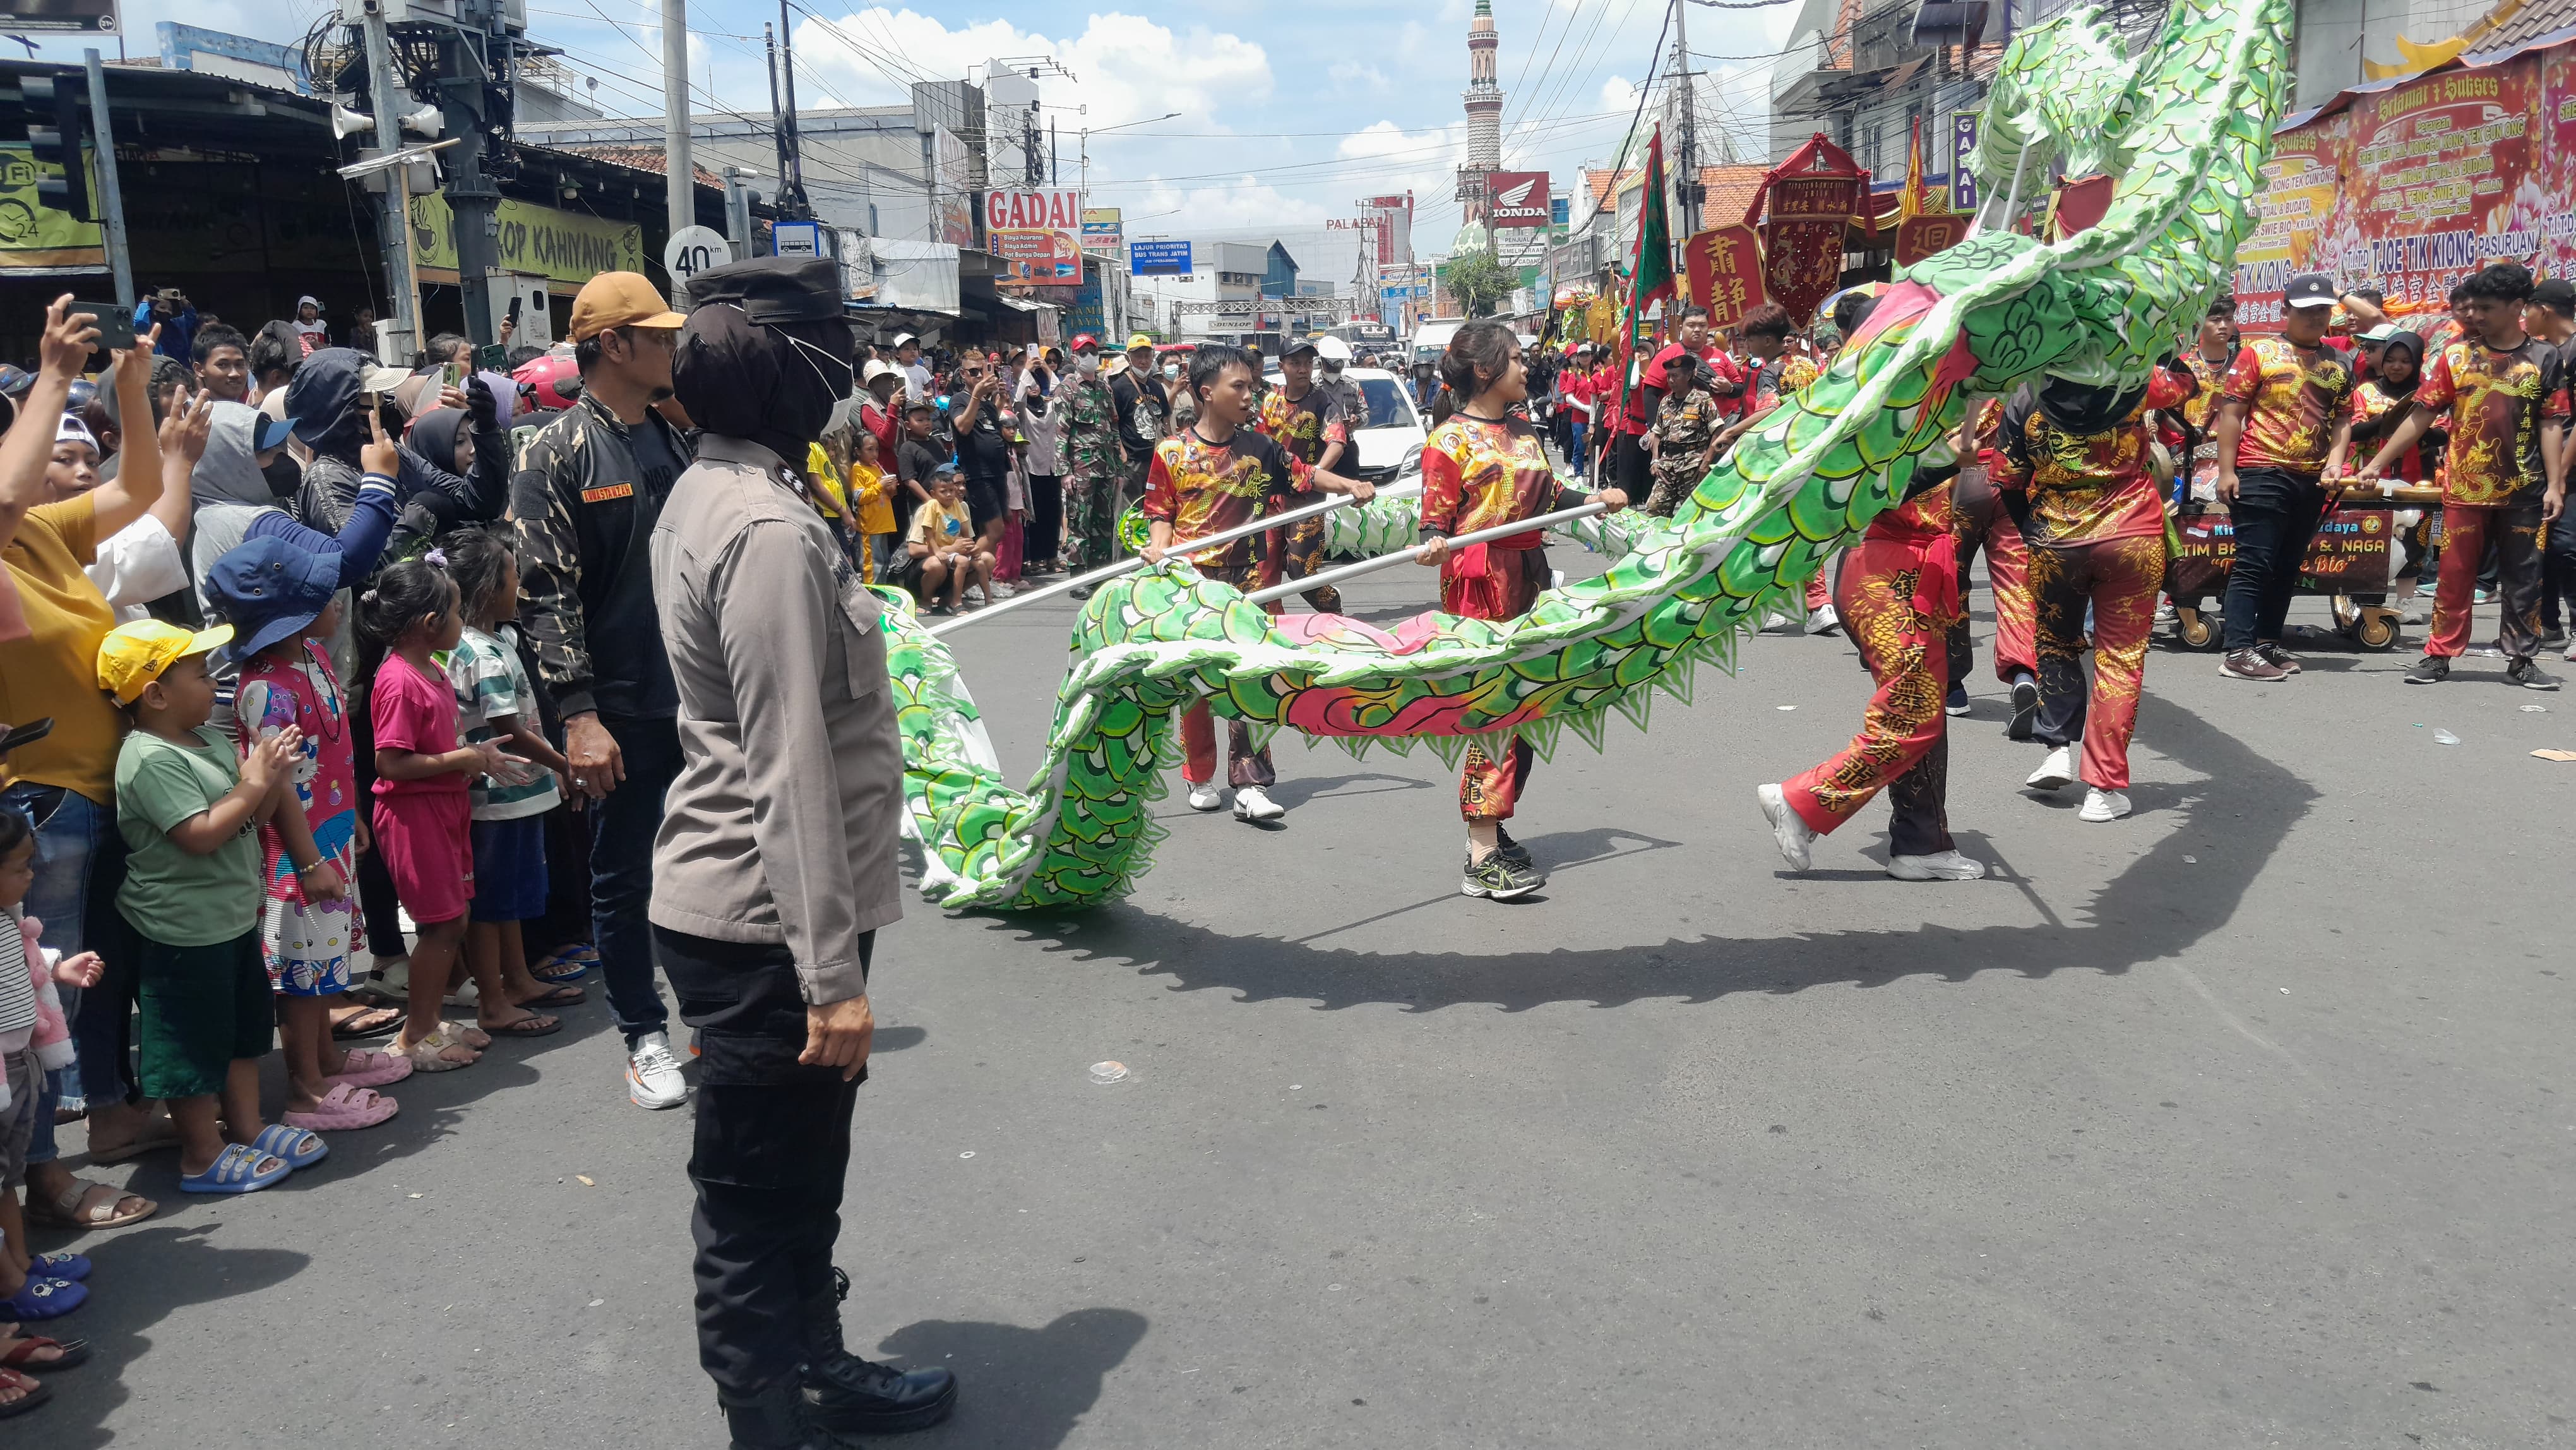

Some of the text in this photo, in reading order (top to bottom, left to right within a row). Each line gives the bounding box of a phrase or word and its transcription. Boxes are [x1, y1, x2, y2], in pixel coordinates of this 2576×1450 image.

[2505, 119, 2525, 138] ONG
[2259, 166, 2281, 178] rayaan
[2273, 179, 2289, 192] KONG
[2291, 176, 2305, 189] TEK
[2305, 173, 2319, 186] CUN
[2320, 169, 2335, 183] ONG
[2406, 190, 2430, 205] TENG
[2431, 186, 2454, 202] SWIE
[2455, 181, 2472, 199] BIO
[989, 191, 1078, 229] GADAI
[2260, 204, 2277, 218] ITUAL
[2286, 199, 2310, 213] BUDAYA
[16, 223, 39, 237] 24
[2260, 222, 2277, 236] SWIE
[2279, 220, 2291, 234] BIO
[1004, 235, 1019, 243] Biaya
[1004, 243, 1019, 252] Biaya
[676, 246, 710, 277] 40
[2372, 238, 2403, 273] TJOE
[2406, 235, 2430, 271] TIK
[2431, 231, 2476, 267] KIONG
[2478, 231, 2534, 257] PASURUAN
[2238, 262, 2255, 294] TIK
[2256, 259, 2291, 292] KIONG
[2111, 447, 2128, 467] BIO
[2318, 523, 2358, 534] daya
[2183, 543, 2209, 558] TIM
[2319, 540, 2334, 553] &
[2342, 539, 2385, 554] NAGA
